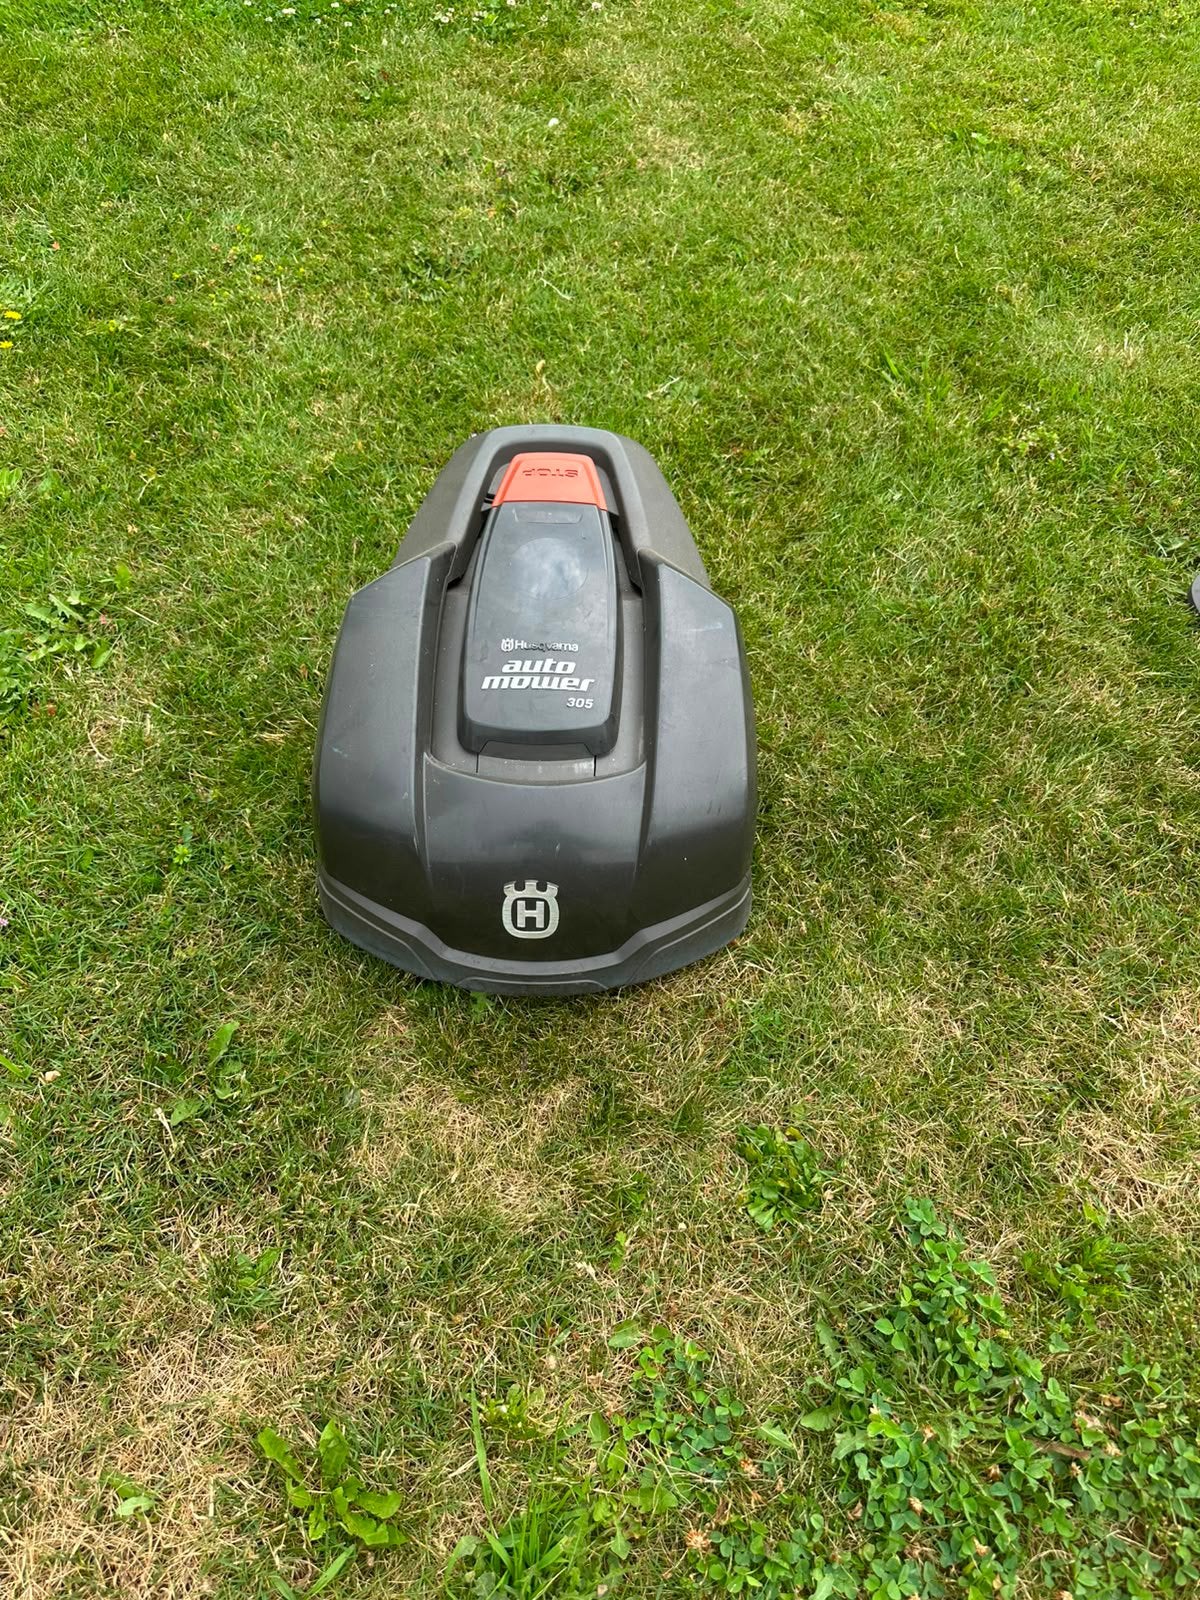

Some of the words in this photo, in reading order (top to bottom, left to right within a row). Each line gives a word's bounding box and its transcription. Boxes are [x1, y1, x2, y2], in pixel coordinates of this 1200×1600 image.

[522, 468, 579, 478] STOP
[514, 640, 579, 652] Husqvarna
[501, 658, 576, 674] auto
[480, 676, 595, 692] mower
[566, 698, 594, 709] 305
[516, 900, 545, 928] H
